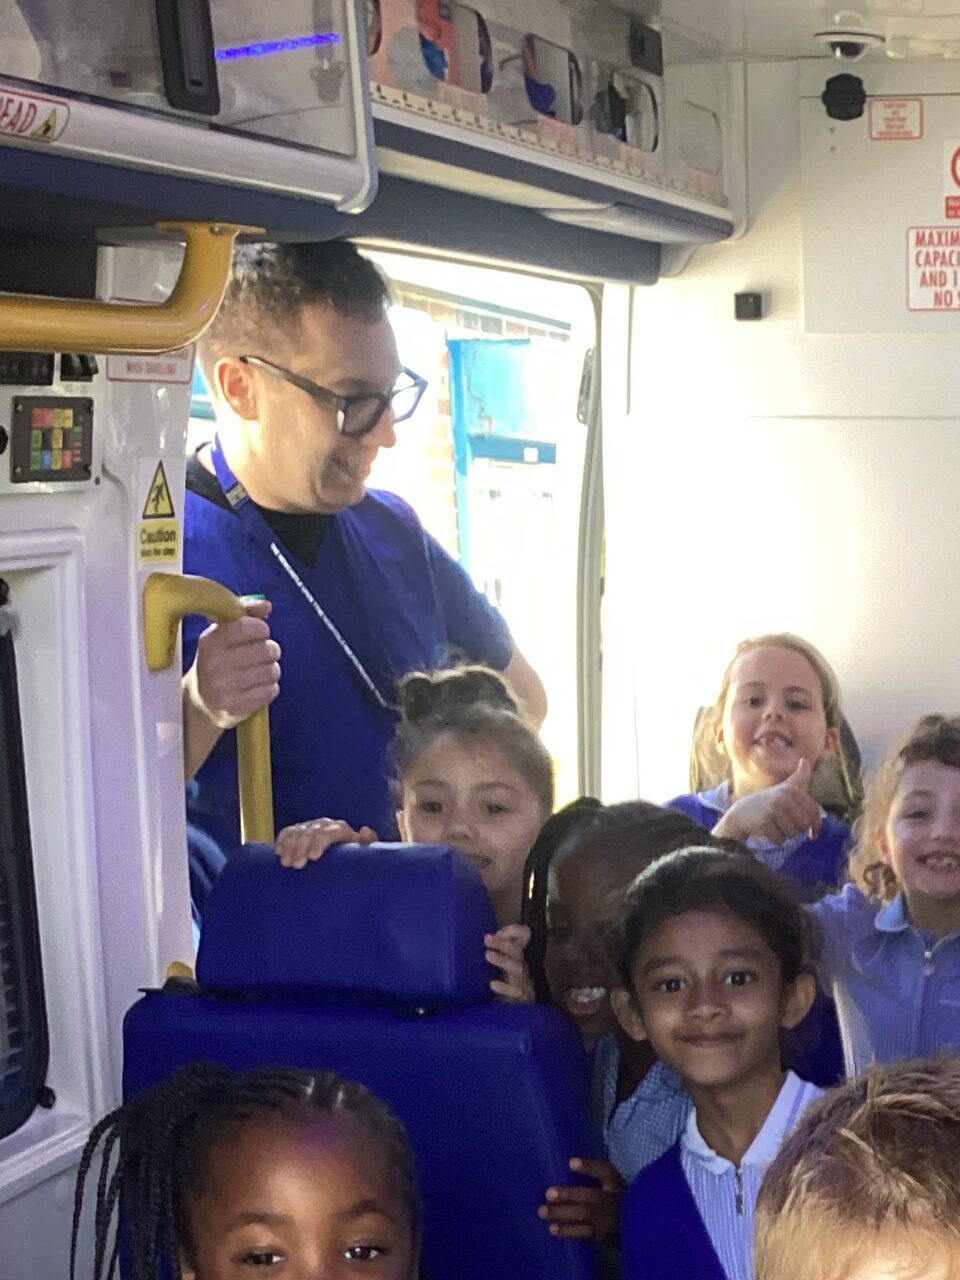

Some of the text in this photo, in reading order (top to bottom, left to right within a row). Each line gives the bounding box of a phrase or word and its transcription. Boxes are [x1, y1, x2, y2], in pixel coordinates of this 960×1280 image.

[919, 270, 947, 288] AND
[952, 270, 959, 287] 1
[933, 289, 953, 307] NO
[141, 529, 176, 544] Caution
